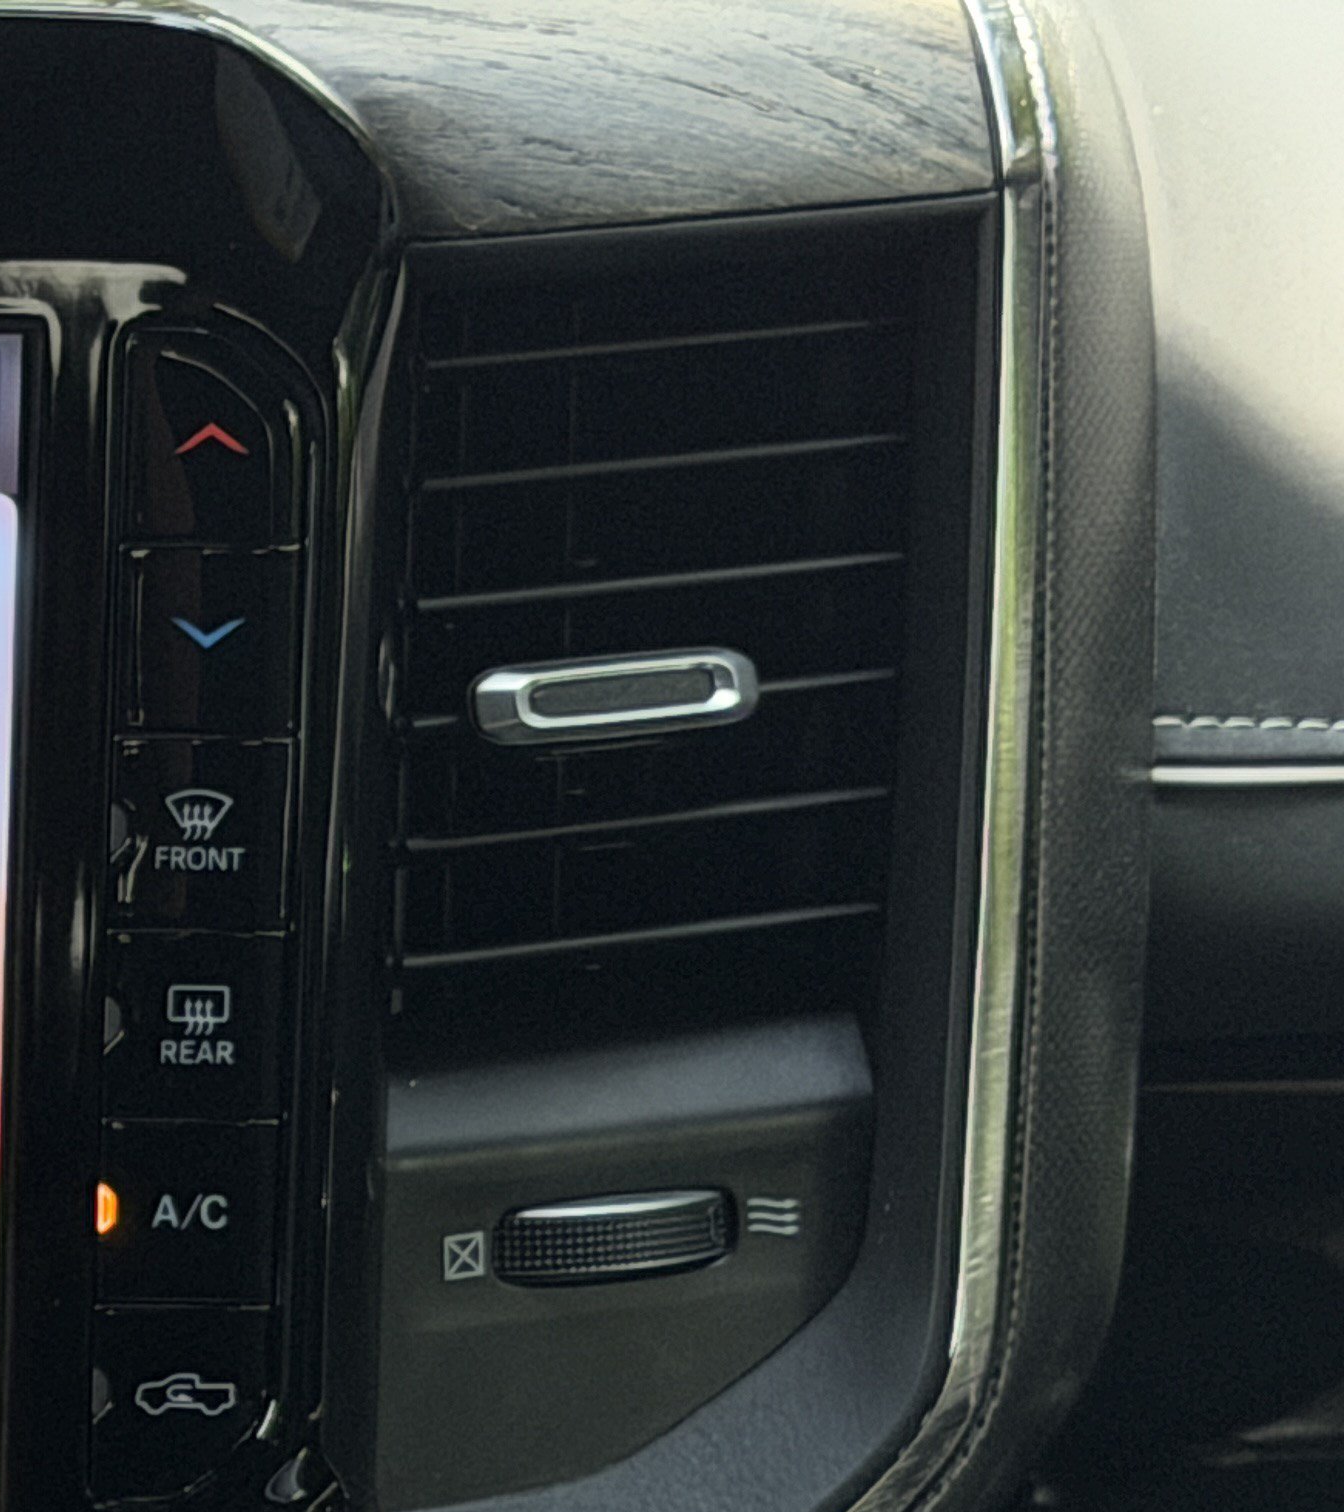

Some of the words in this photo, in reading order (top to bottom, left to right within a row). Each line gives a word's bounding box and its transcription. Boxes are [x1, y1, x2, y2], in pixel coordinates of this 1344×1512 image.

[154, 847, 244, 871] FRONT
[160, 1041, 234, 1064] REAR
[151, 1196, 228, 1229] A/C
